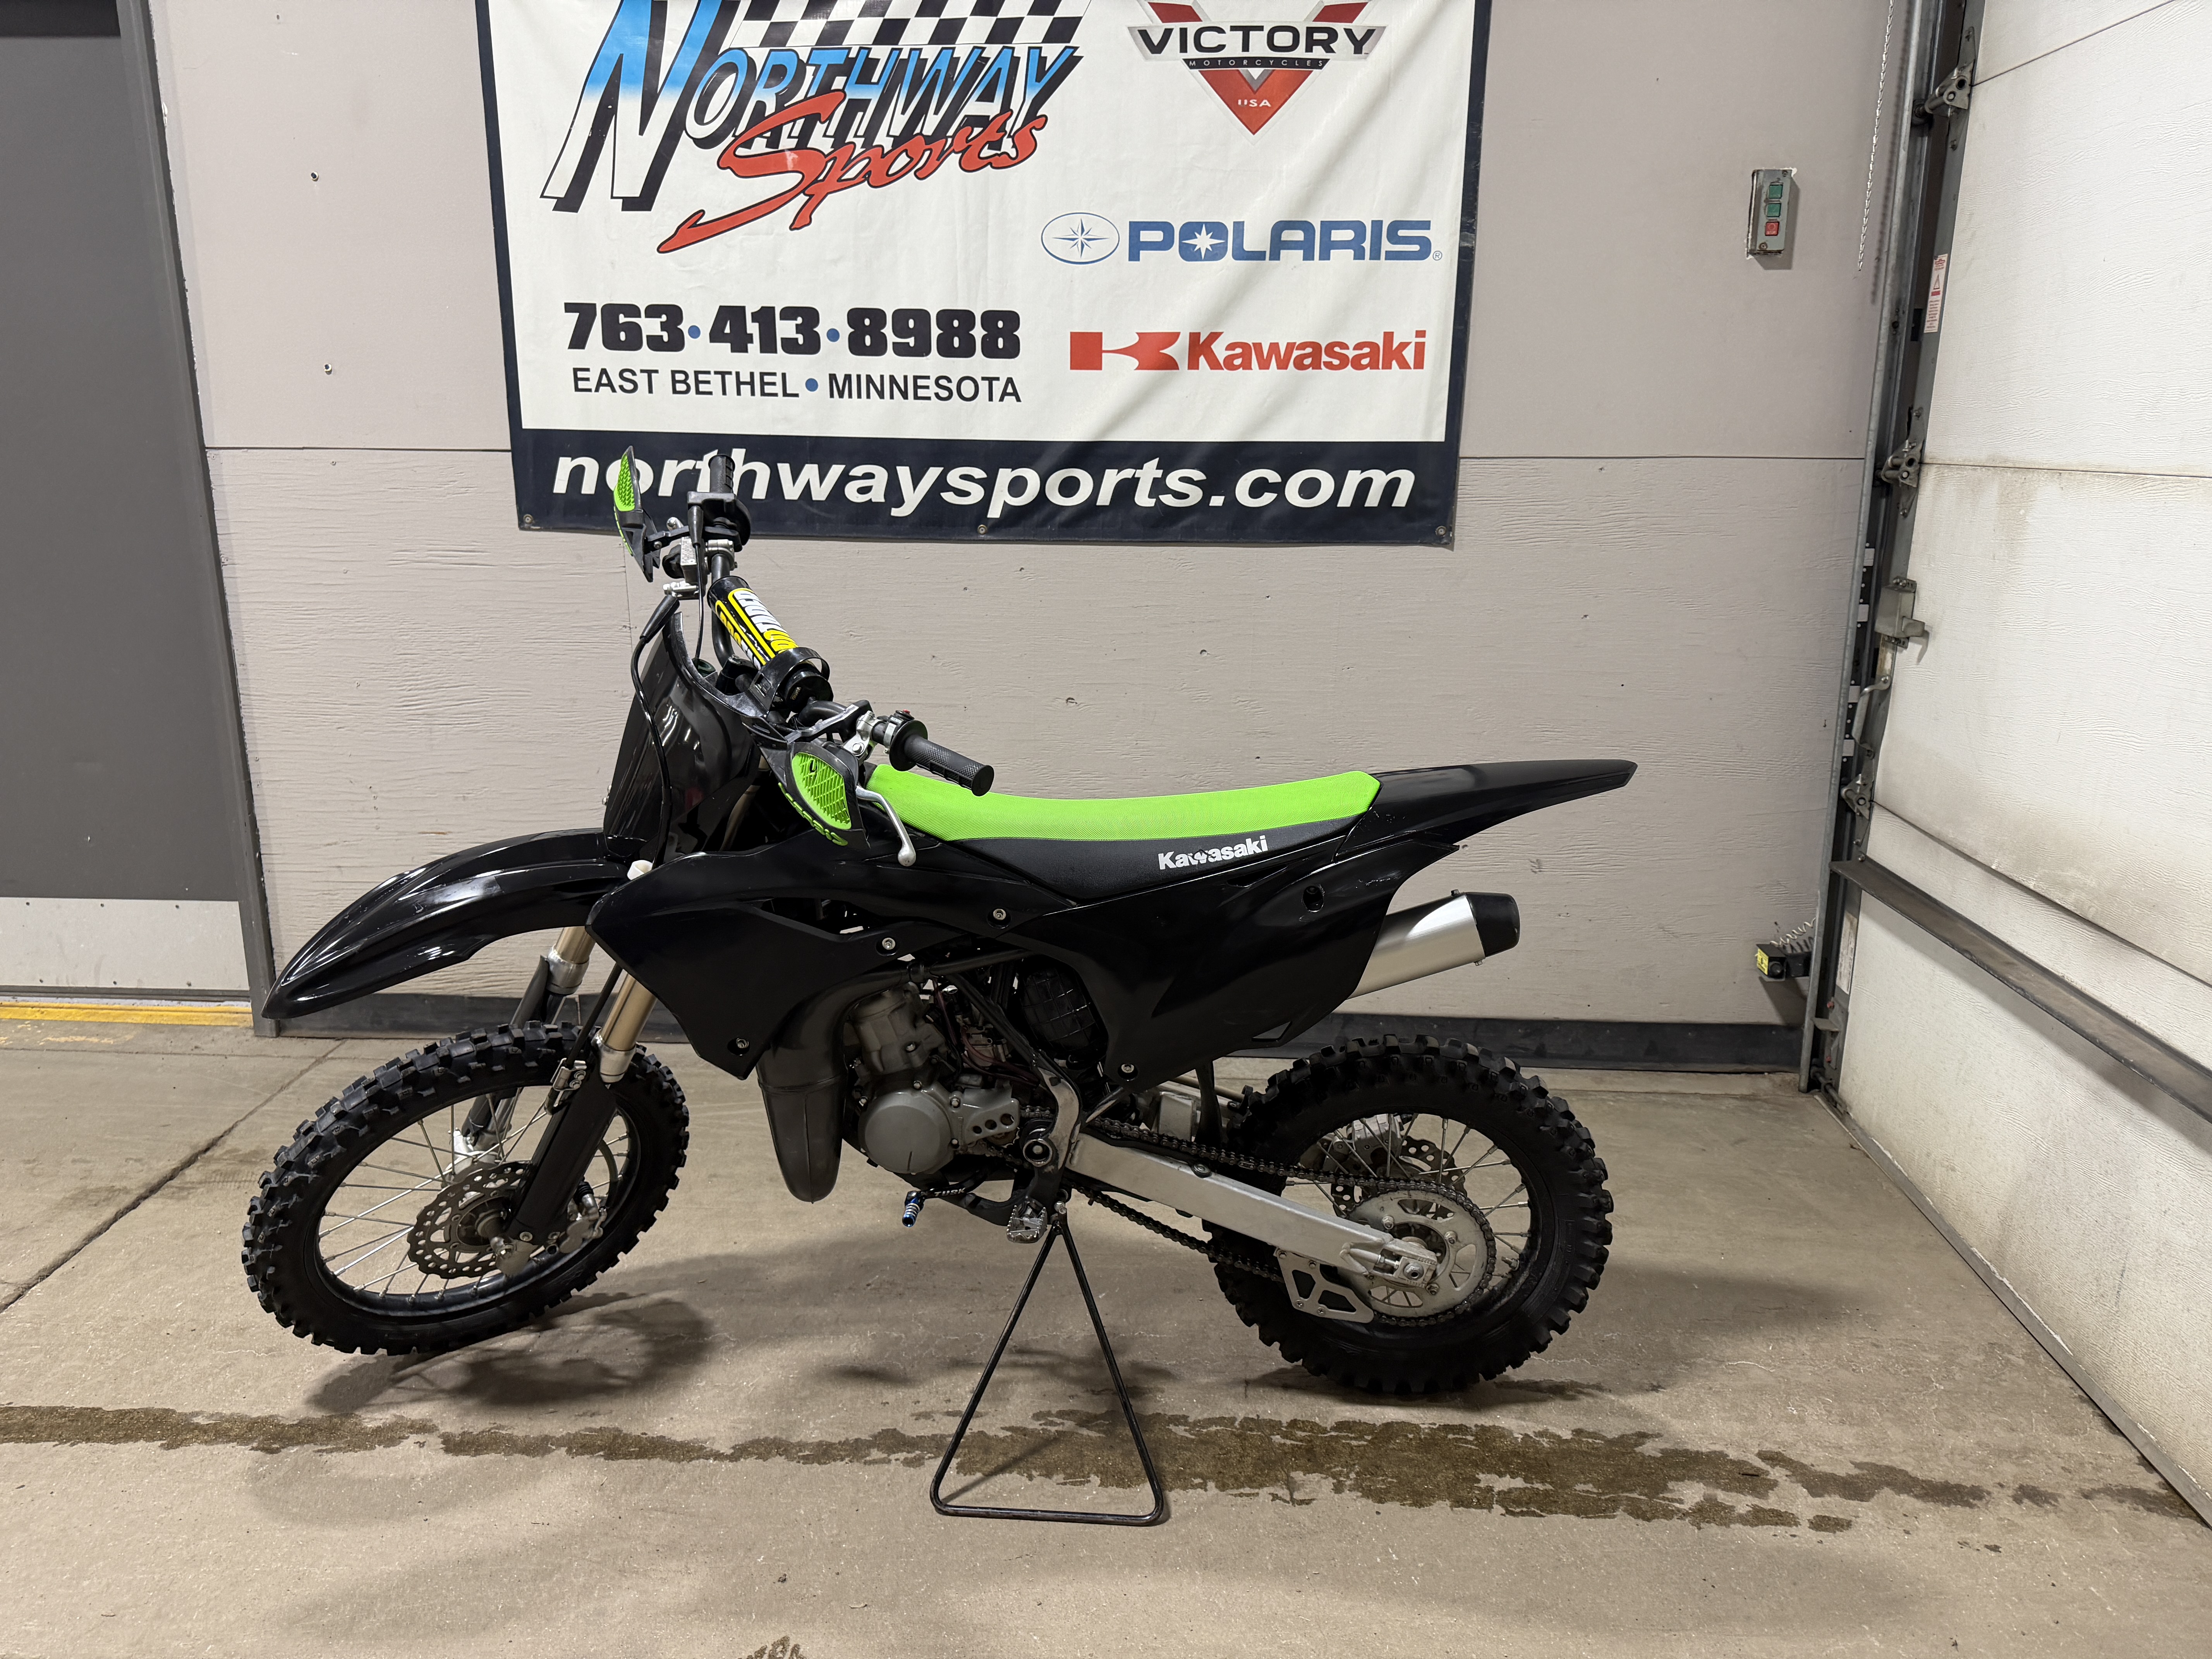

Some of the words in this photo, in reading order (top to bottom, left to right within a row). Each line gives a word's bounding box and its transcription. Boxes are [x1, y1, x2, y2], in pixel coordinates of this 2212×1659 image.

[1137, 26, 1376, 55] VICTORY
[540, 0, 1084, 212] NORTHWAY
[1238, 99, 1271, 107] USA
[657, 88, 1047, 254] Sports
[1187, 330, 1427, 371] Kawasaki
[572, 368, 659, 395] EAST
[670, 369, 800, 398] BETHEL
[828, 373, 1022, 403] MINNESOTA
[553, 448, 1415, 518] northwaysports.com
[1158, 835, 1268, 870] Kawasaki
